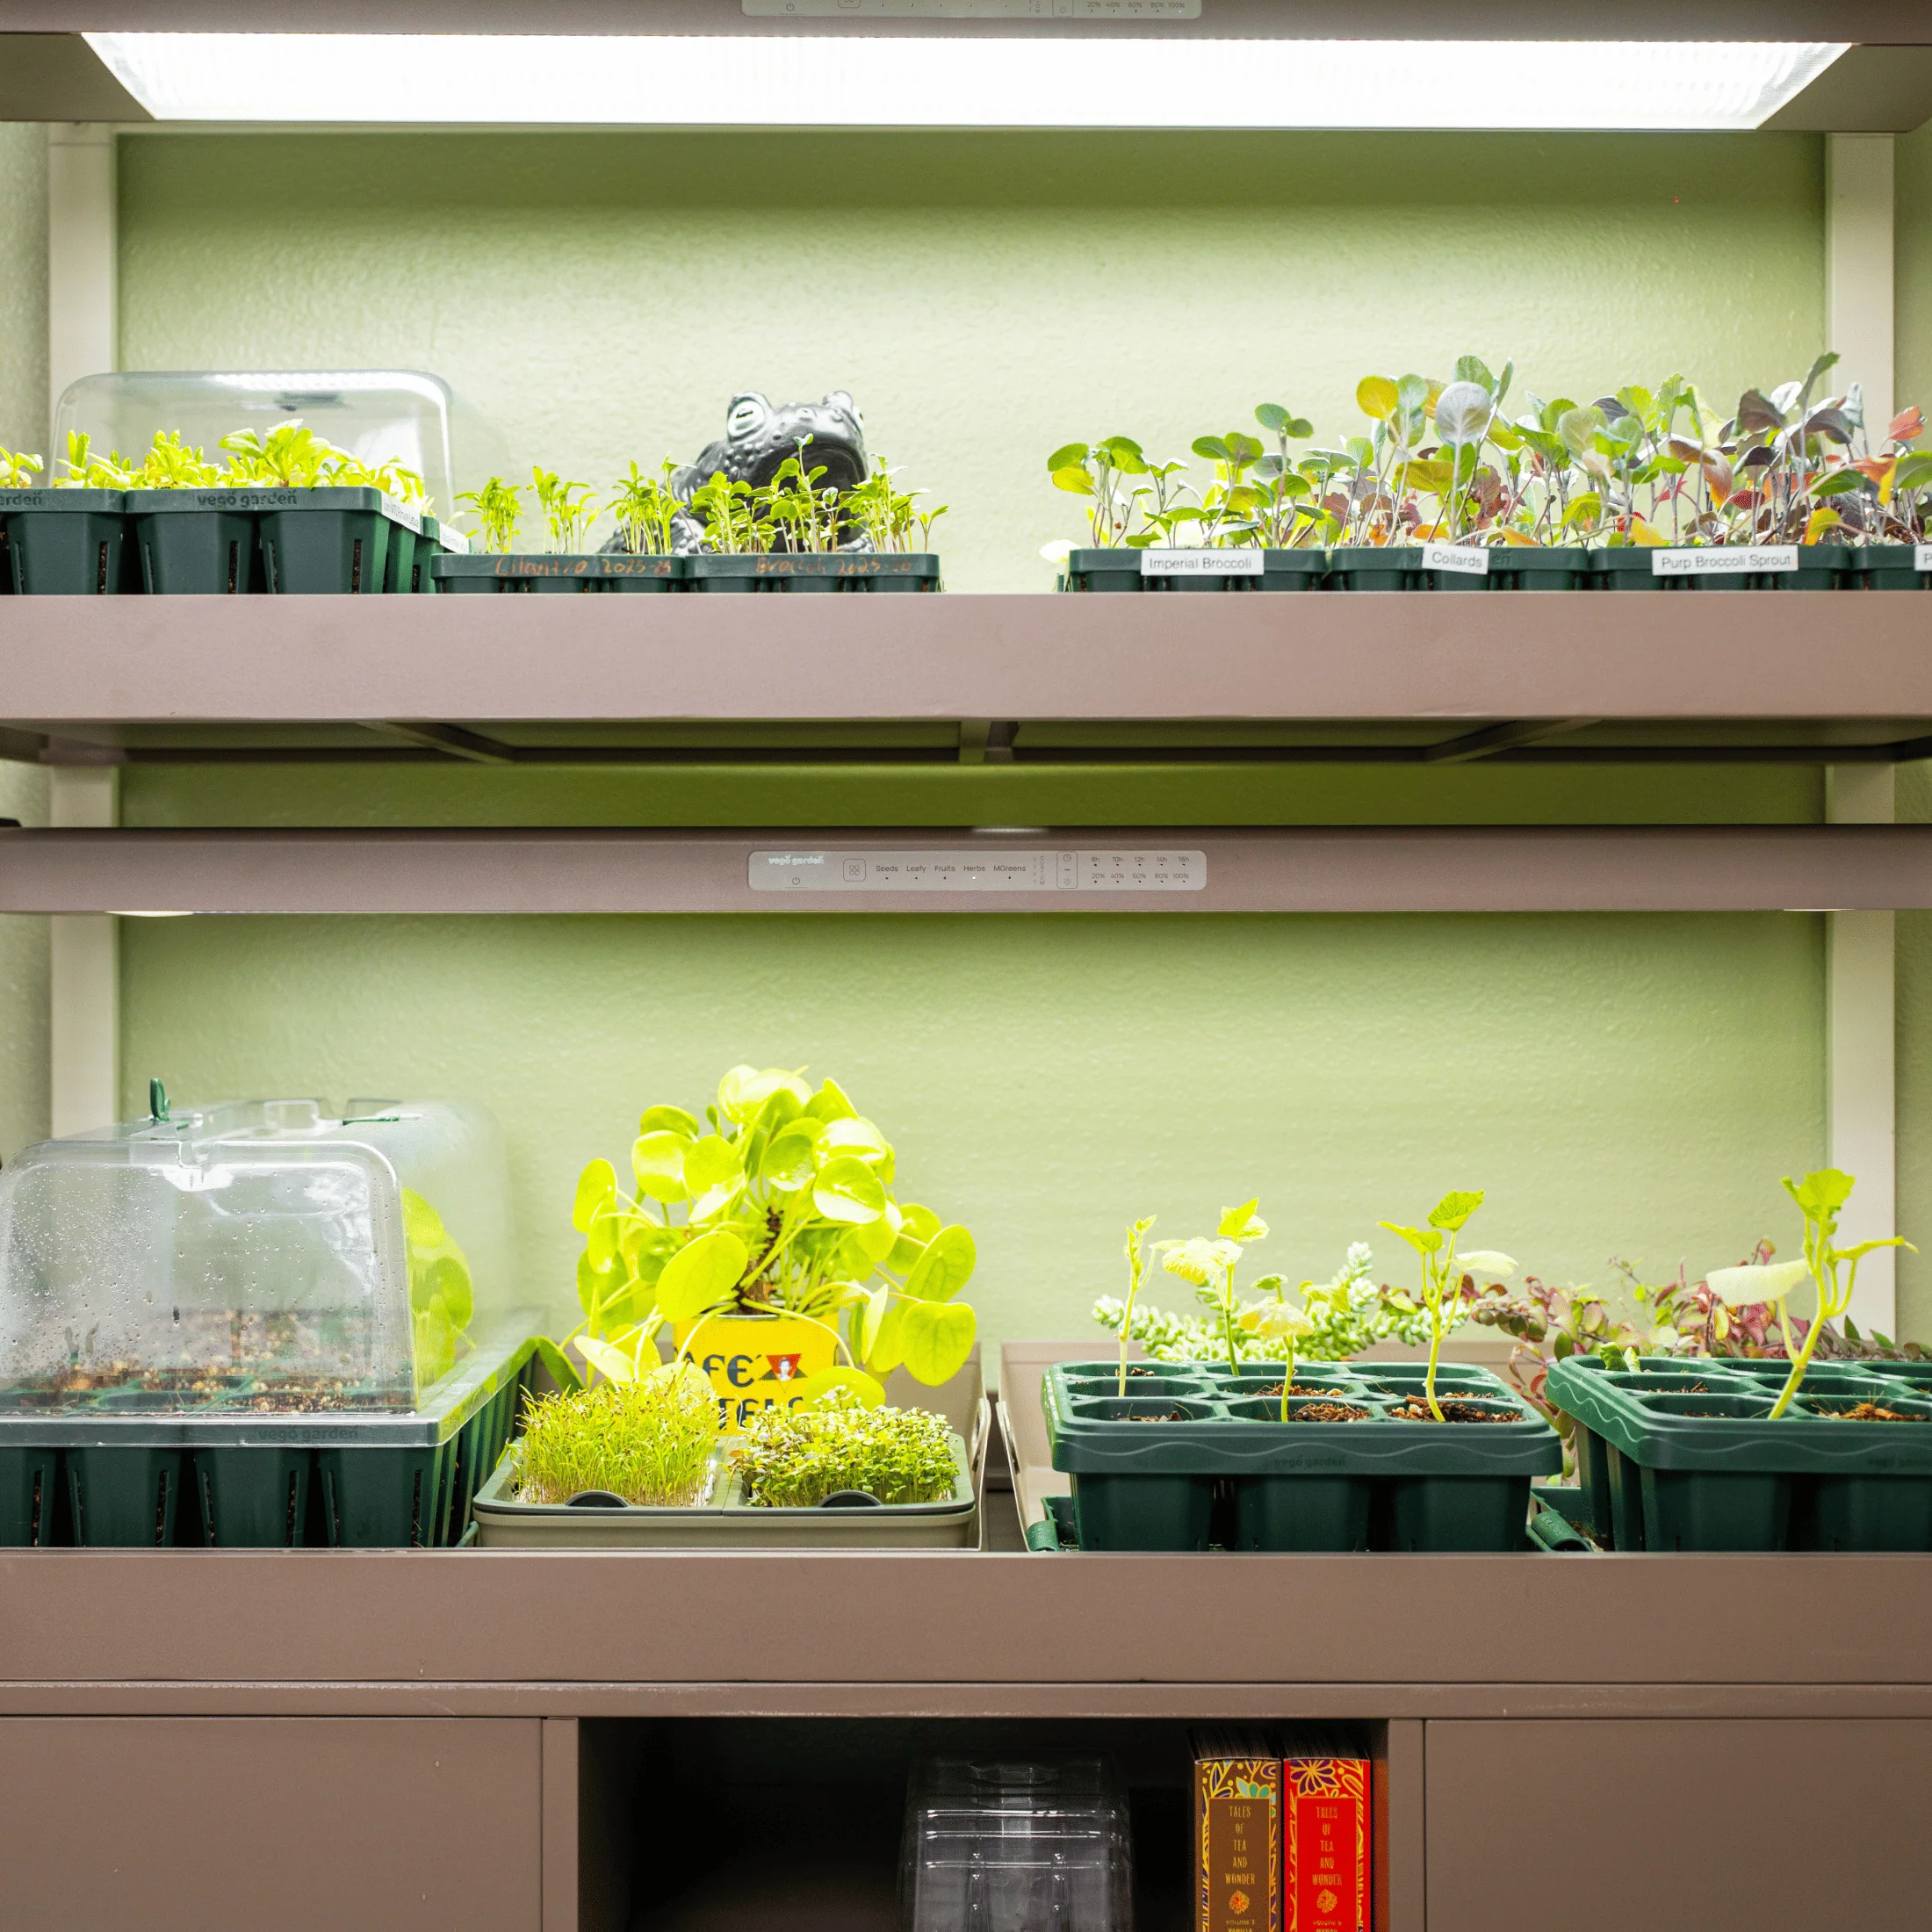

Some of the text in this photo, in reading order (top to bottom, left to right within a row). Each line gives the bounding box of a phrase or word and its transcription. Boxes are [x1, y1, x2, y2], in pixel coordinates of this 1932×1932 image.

[1149, 557, 1252, 570] Imperial Broccoli
[1431, 551, 1483, 568] Collards
[1662, 554, 1791, 571] Purp Broccoli Sprout
[1229, 1806, 1251, 1818] TALES
[1316, 1806, 1337, 1819] TALES
[1235, 1822, 1244, 1835] OF
[1322, 1823, 1330, 1835] OF
[1234, 1839, 1247, 1851] TEA
[1320, 1840, 1334, 1852] TEA
[1232, 1856, 1248, 1869] AND
[1320, 1856, 1335, 1869] AND
[1224, 1872, 1256, 1885] WONDER
[1312, 1873, 1343, 1885] WONDER
